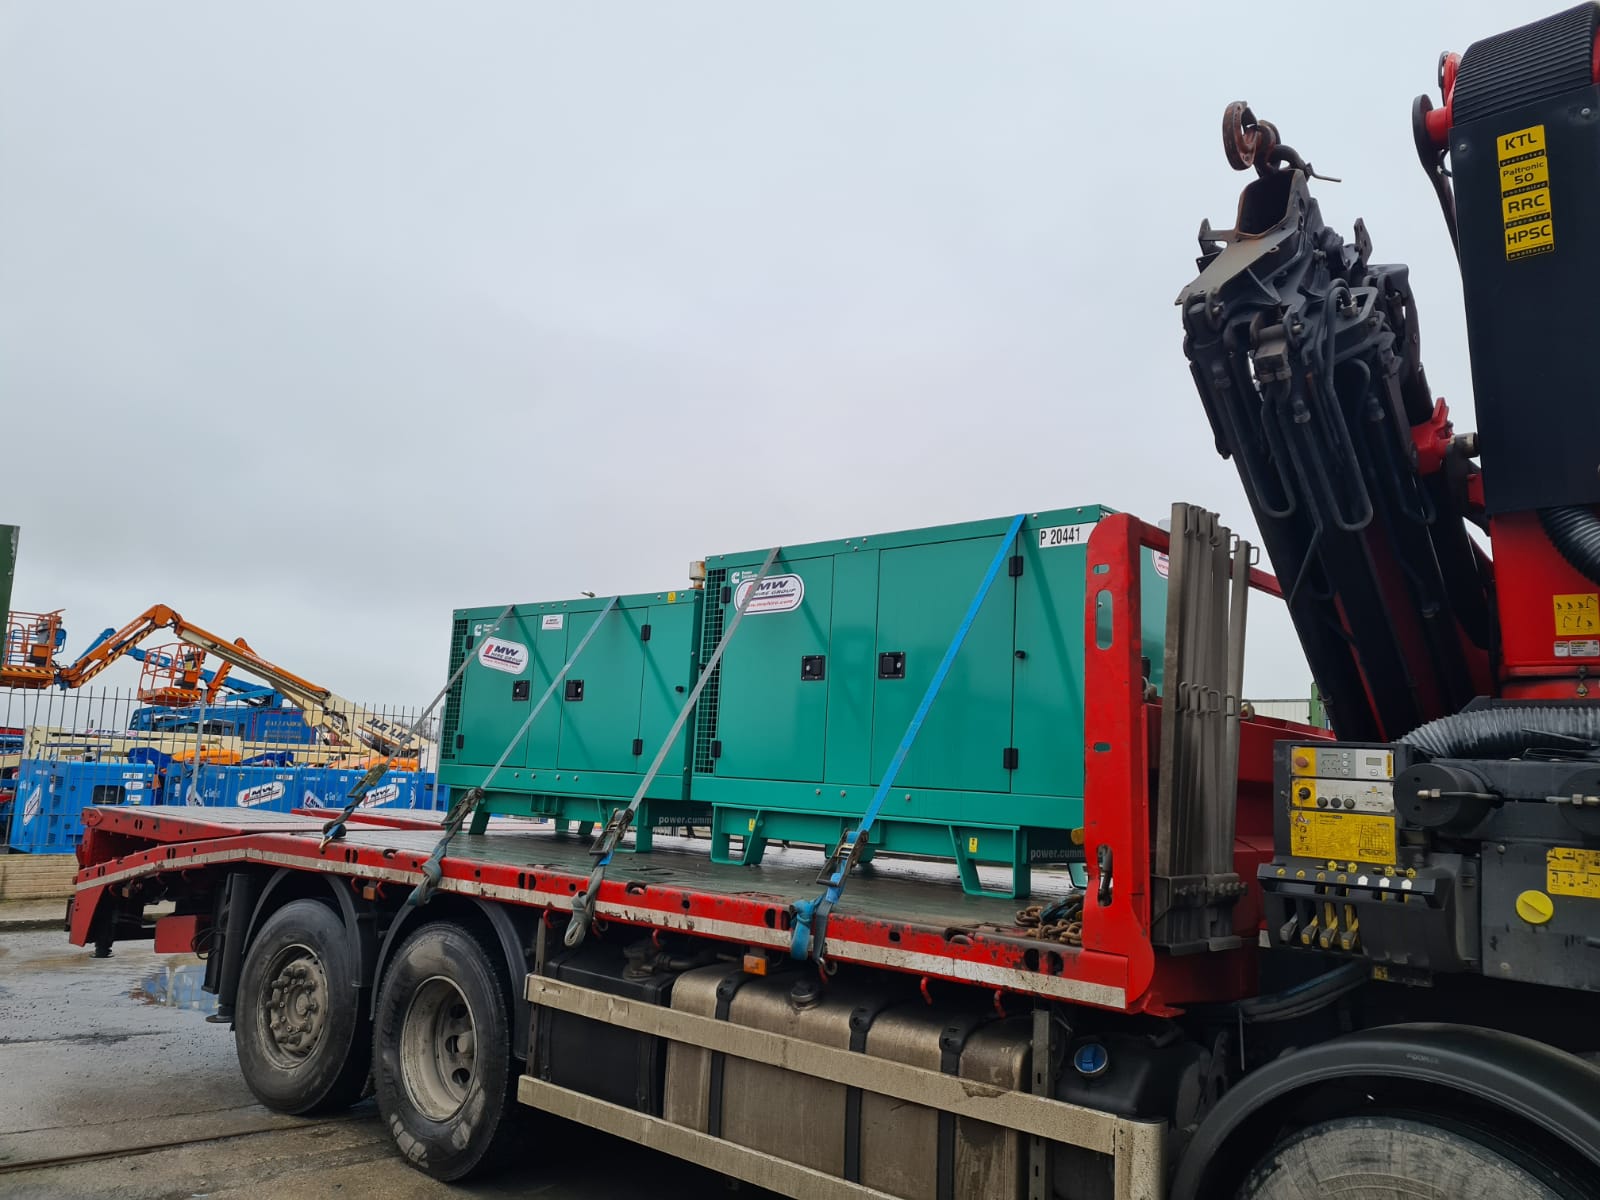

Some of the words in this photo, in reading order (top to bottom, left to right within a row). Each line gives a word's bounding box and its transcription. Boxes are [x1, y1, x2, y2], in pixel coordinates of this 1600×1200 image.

[1505, 133, 1537, 150] KTL
[1503, 162, 1544, 177] Paltronic
[1514, 172, 1534, 185] 50
[1508, 194, 1545, 213] RRC
[1507, 224, 1551, 245] HPSC
[1040, 530, 1046, 546] P
[1050, 526, 1080, 545] 20441
[757, 580, 789, 591] MW
[494, 645, 519, 656] MW
[366, 719, 390, 731] JLG
